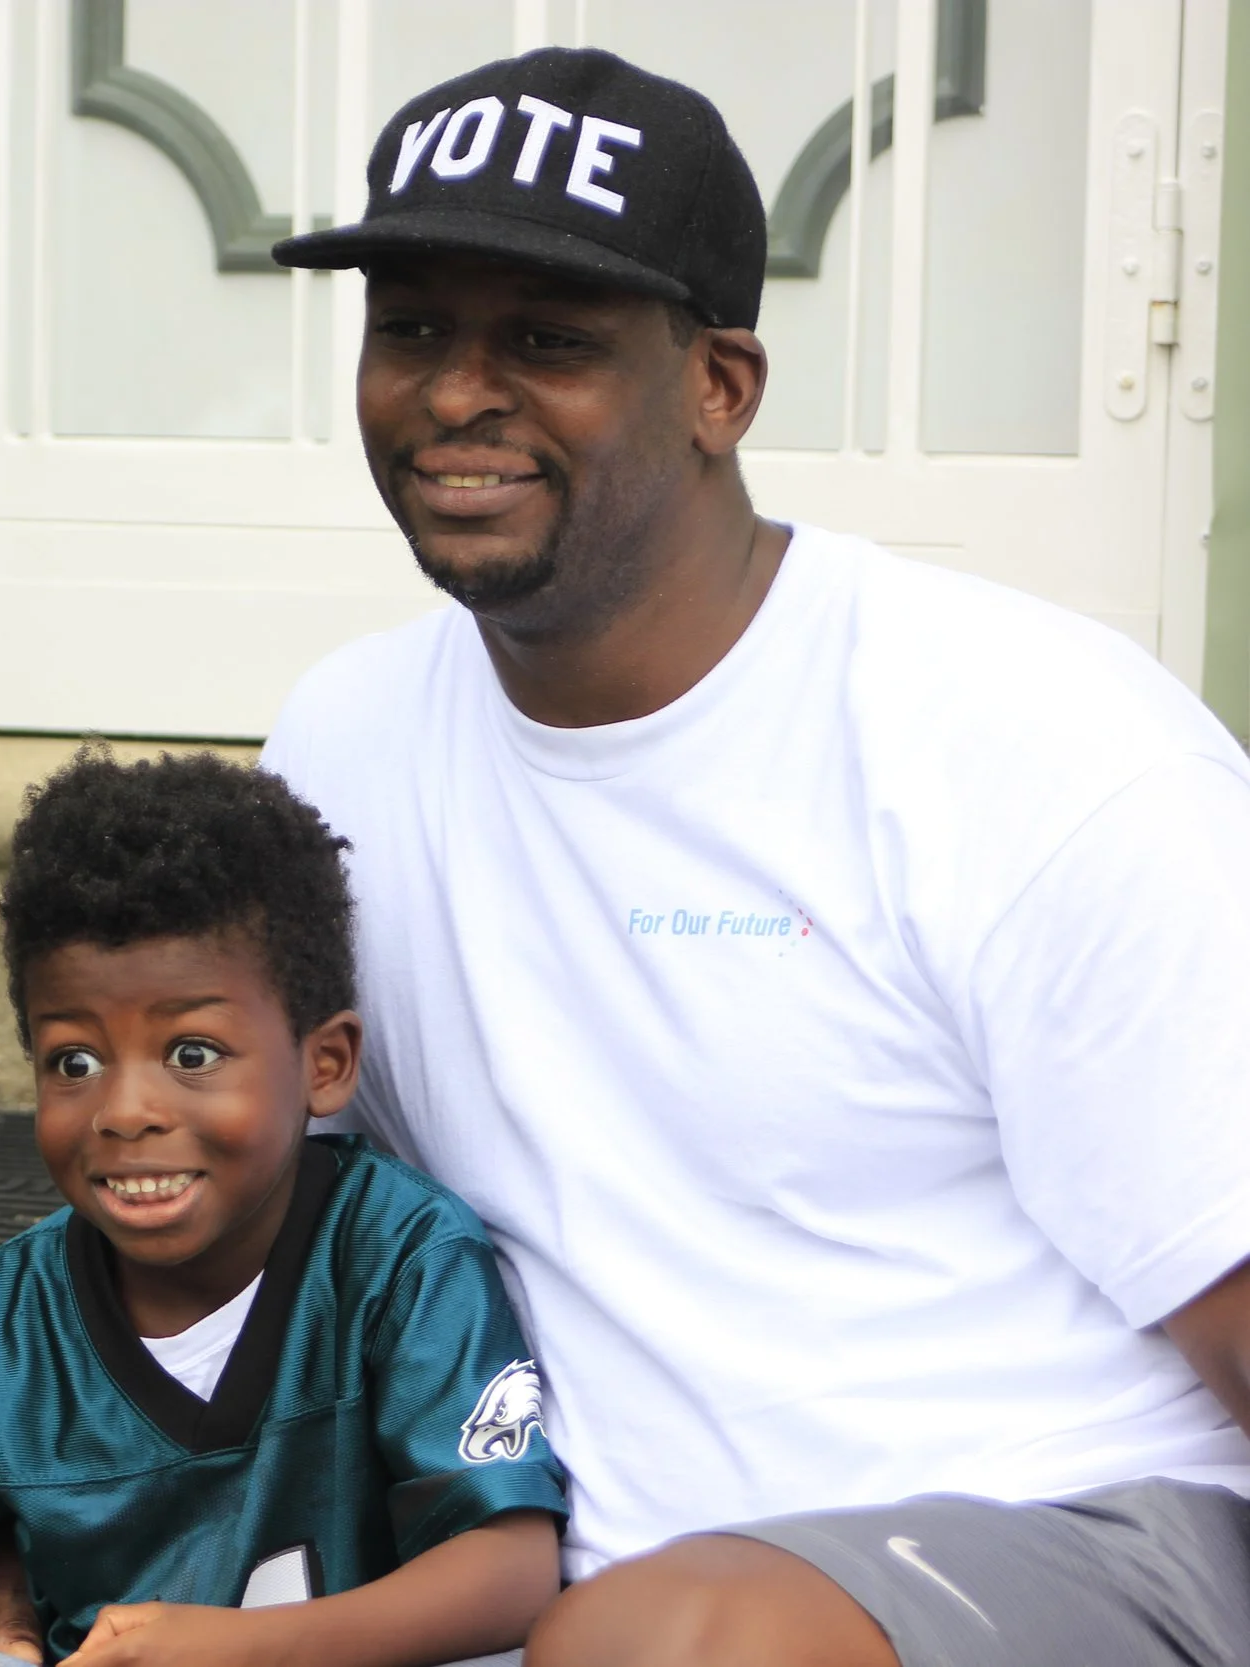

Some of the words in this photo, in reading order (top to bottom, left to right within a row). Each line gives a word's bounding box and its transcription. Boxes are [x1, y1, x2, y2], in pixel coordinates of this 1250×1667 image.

[389, 93, 643, 215] VOTE
[628, 908, 665, 935] For
[671, 908, 711, 936] Our
[716, 909, 792, 937] Future
